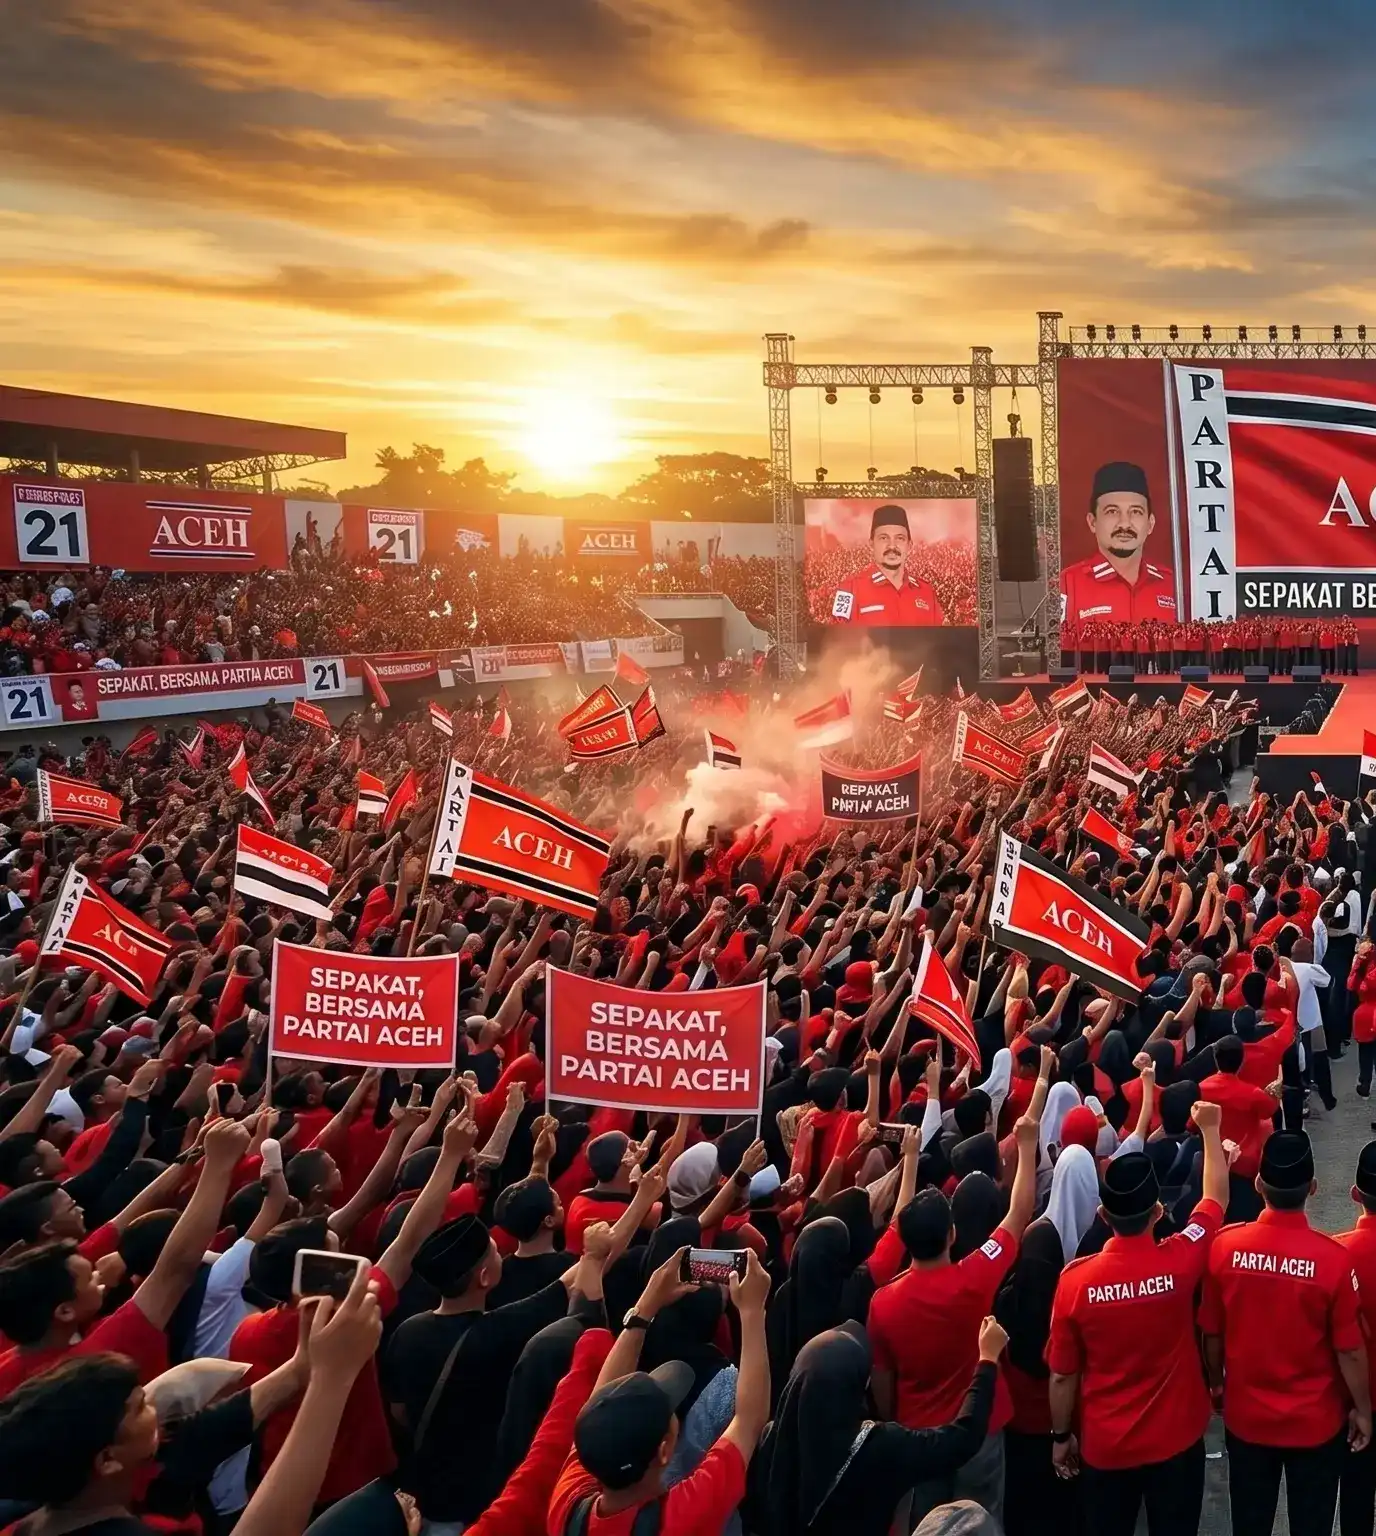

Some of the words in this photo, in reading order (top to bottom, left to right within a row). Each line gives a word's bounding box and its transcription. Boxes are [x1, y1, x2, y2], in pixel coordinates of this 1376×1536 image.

[1188, 373, 1230, 619] PARTAI
[24, 509, 80, 557] 21
[152, 515, 248, 548] ACEH
[376, 527, 412, 560] 21
[581, 532, 637, 549] ACEH
[1243, 581, 1345, 609] SEPAKAT
[160, 668, 219, 690] BERSAMA
[312, 662, 339, 691] 21
[7, 686, 47, 720] 21
[875, 795, 910, 812] ACEH
[493, 825, 574, 872] ACEH
[1041, 900, 1114, 958] ACEH
[310, 966, 425, 1000] SEPAKAT,
[305, 992, 425, 1021] BERSAMA
[590, 1001, 728, 1037] SEPAKAT,
[282, 1013, 371, 1043] PARTAI
[376, 1025, 443, 1048] ACEH
[585, 1030, 729, 1062] BERSAMA
[560, 1055, 663, 1089] PARTAI
[671, 1067, 751, 1092] ACEH
[1232, 1250, 1277, 1272] PARTAI
[1279, 1259, 1315, 1278] ACEH
[1087, 1281, 1134, 1303] PARTAI
[1138, 1274, 1174, 1296] ACEH
